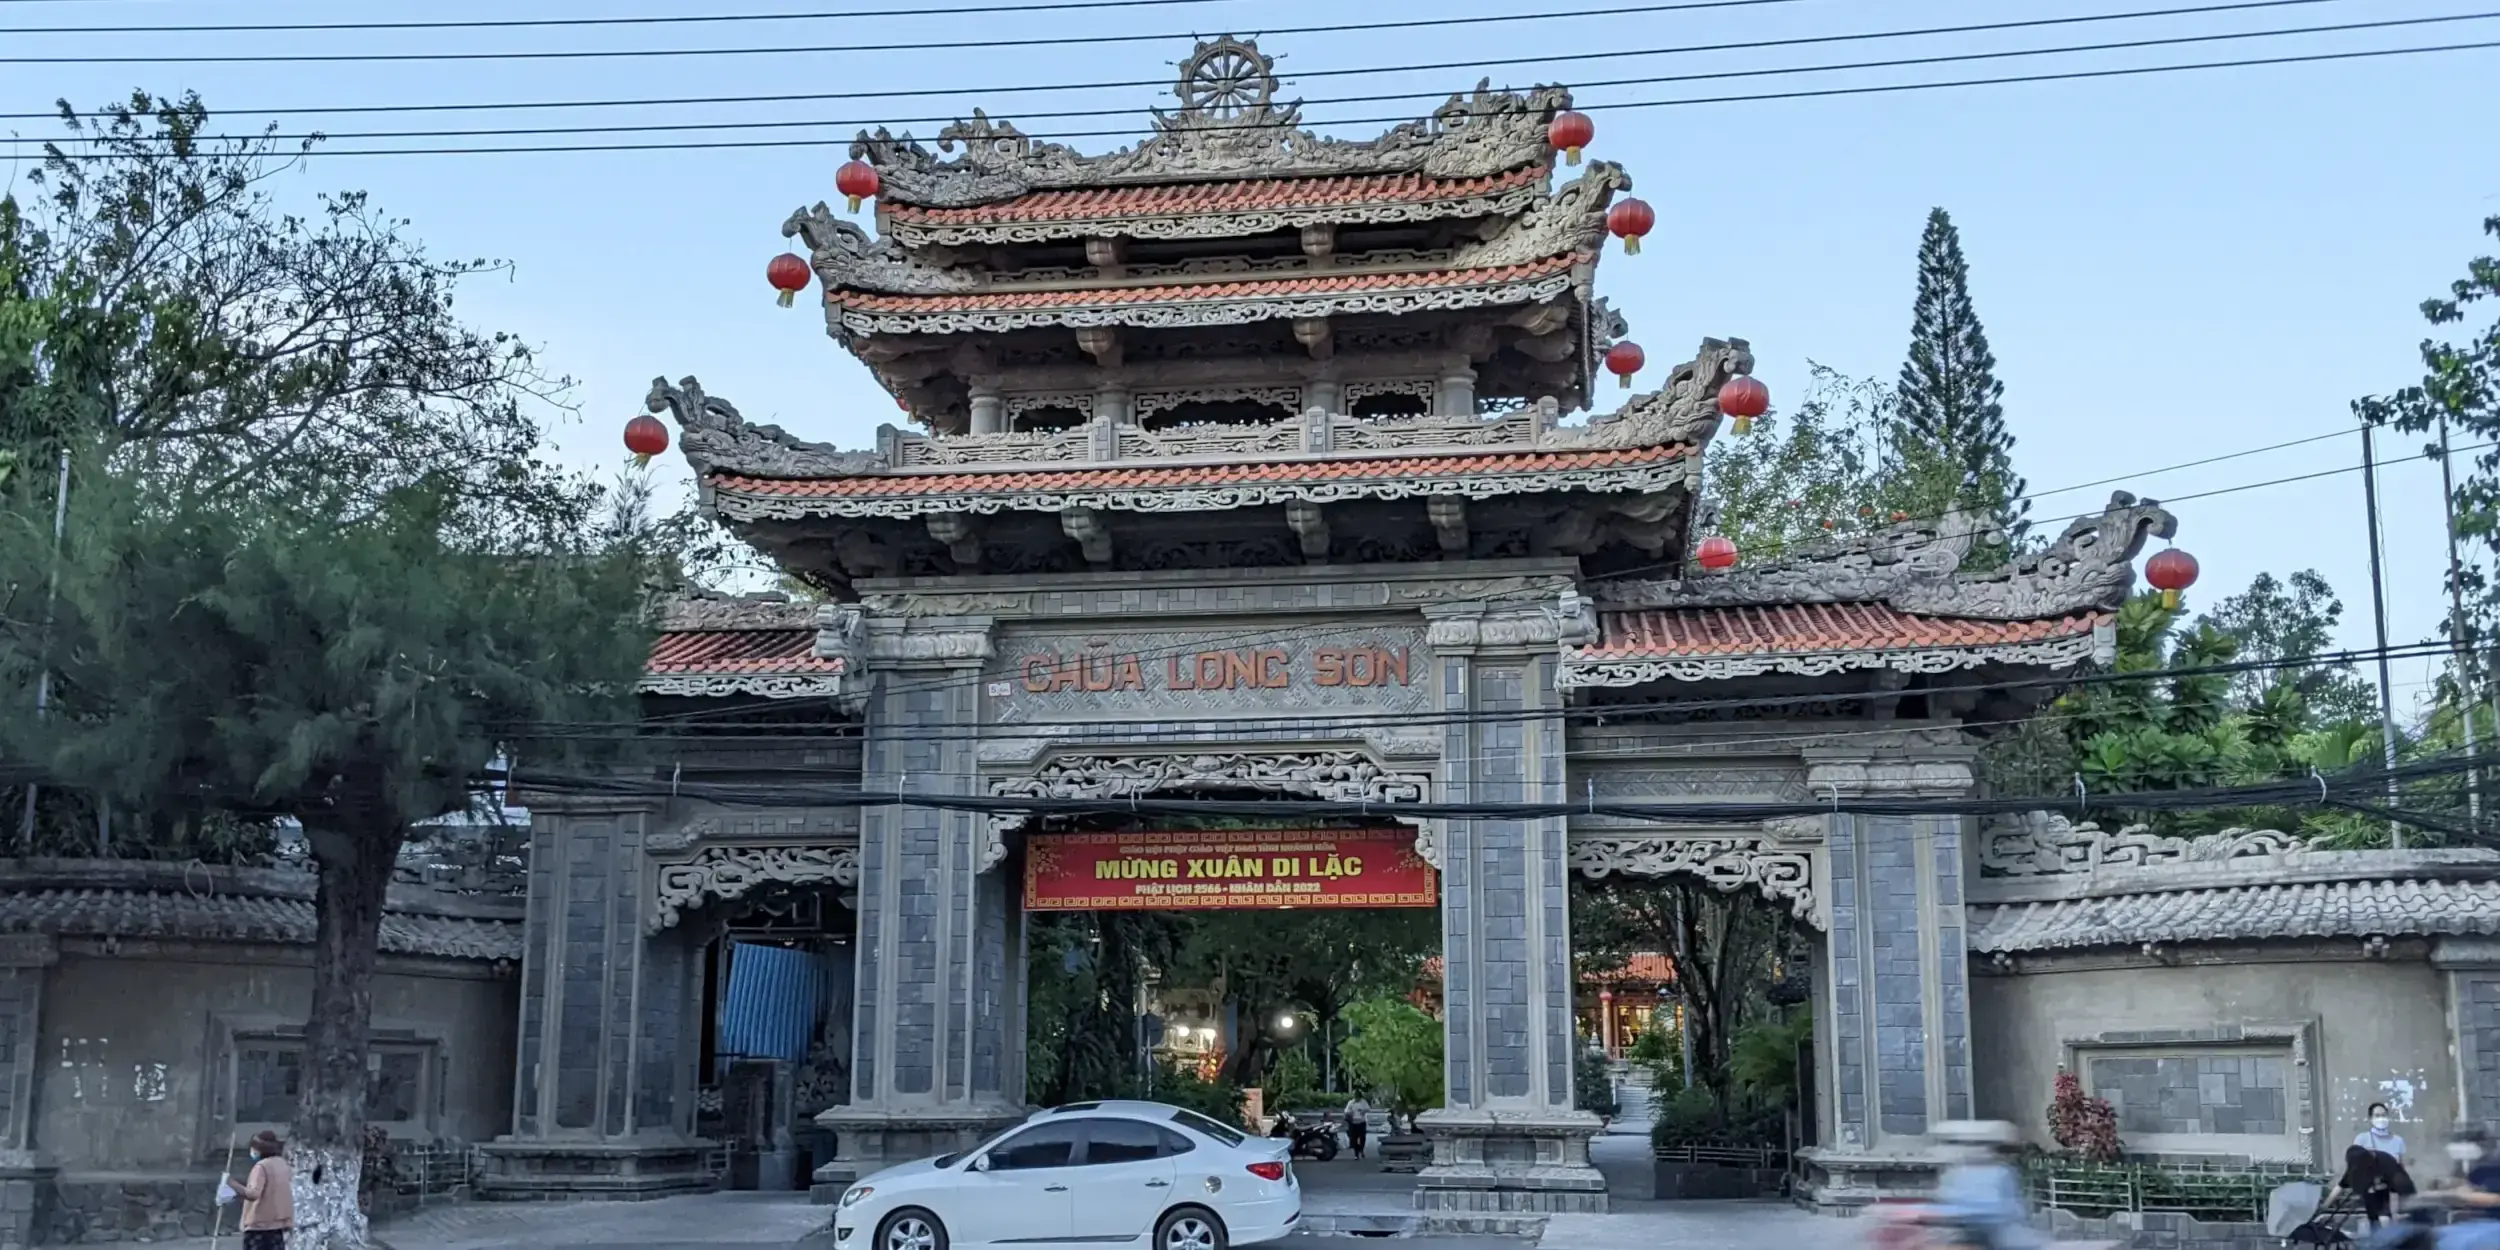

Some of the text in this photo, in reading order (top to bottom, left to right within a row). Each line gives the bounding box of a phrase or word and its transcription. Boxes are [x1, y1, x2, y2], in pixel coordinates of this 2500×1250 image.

[1168, 648, 1289, 690] LONG
[1096, 853, 1363, 880] MỪNG XUÂN DI LẶC
[1135, 882, 1165, 896] PHẬT
[1166, 884, 1192, 896] LỊCH
[1193, 883, 1222, 893] 2566
[1228, 881, 1265, 894] NHÂM
[1292, 882, 1321, 893] 2022
